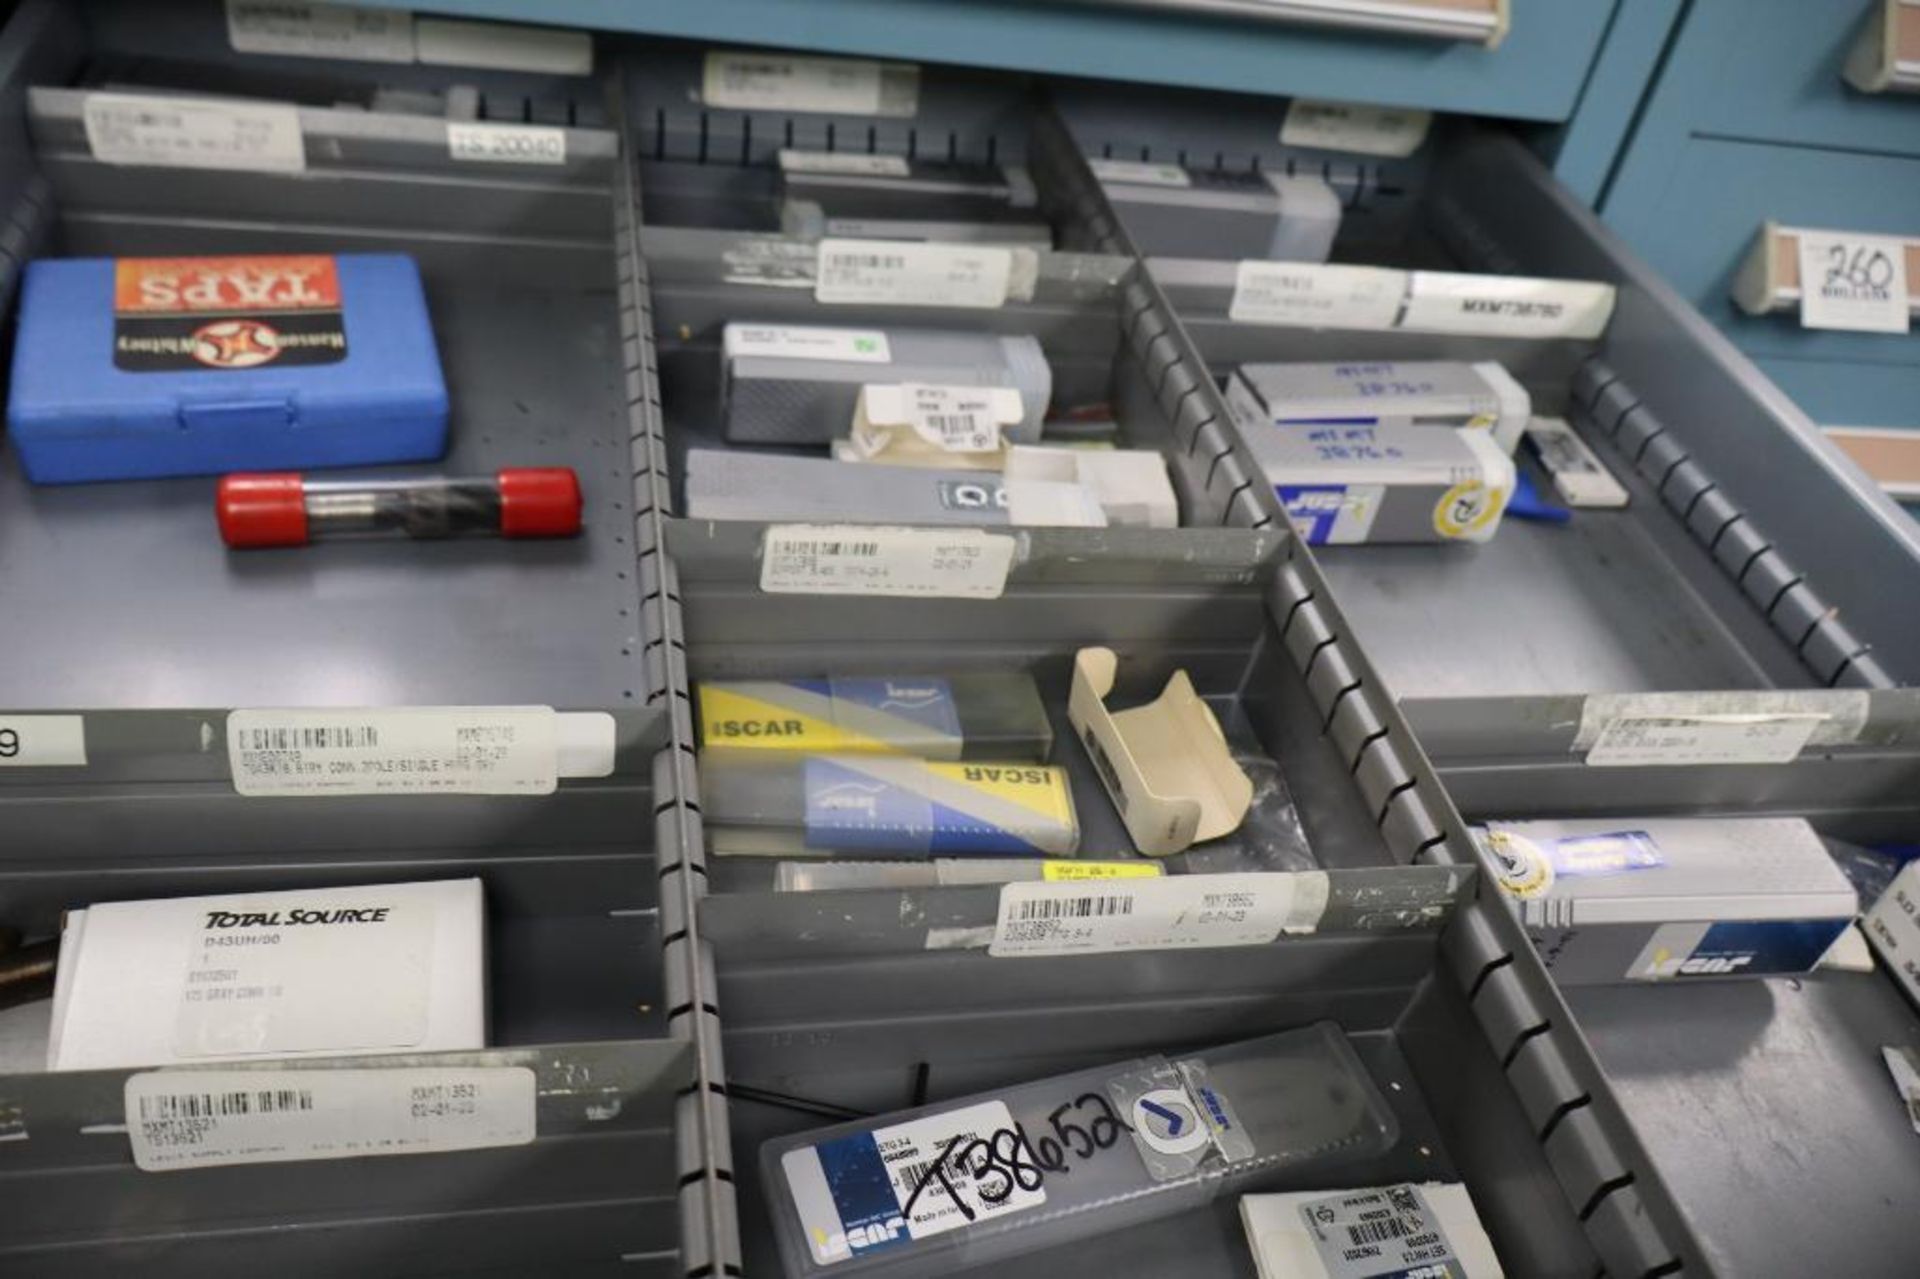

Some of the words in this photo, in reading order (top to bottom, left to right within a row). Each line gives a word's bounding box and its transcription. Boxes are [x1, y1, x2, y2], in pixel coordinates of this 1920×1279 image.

[1827, 245, 1894, 287] 260
[139, 266, 321, 304] TAPS
[712, 719, 804, 737] ISCAR
[964, 766, 1051, 785] ISCAR
[204, 911, 281, 930] TOTAL
[284, 907, 391, 926] SOURCE
[902, 1092, 1136, 1221] T38652
